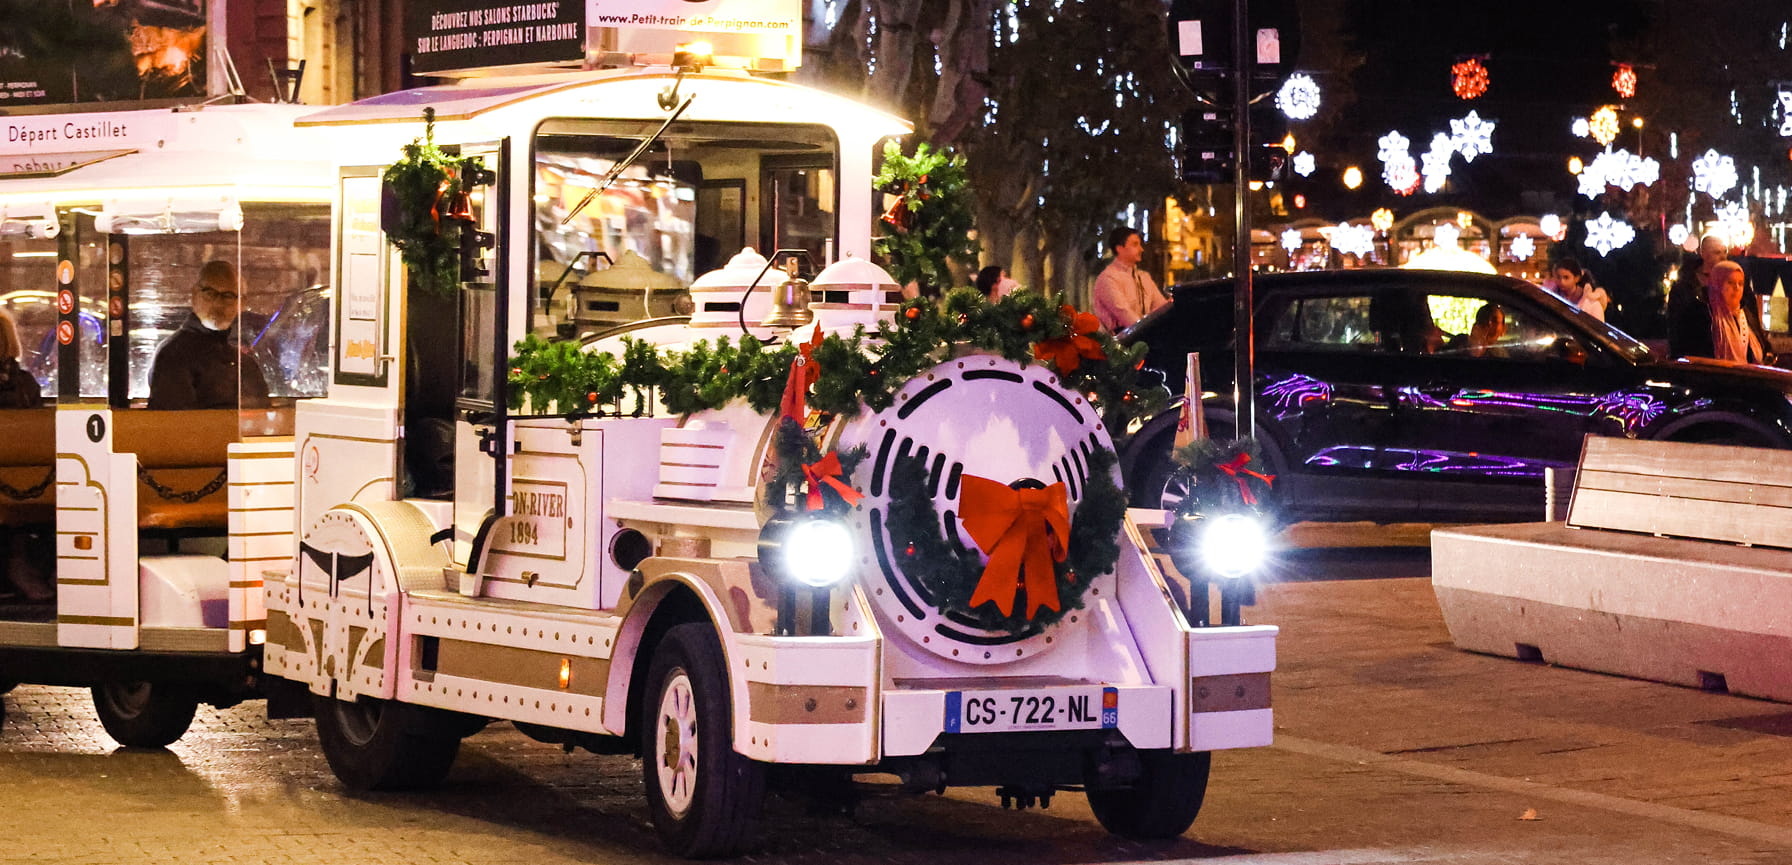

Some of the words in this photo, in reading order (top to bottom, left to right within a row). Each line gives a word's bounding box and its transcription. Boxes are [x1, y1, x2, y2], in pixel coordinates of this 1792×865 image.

[431, 11, 467, 30] DÉCOUVREZ
[469, 10, 483, 27] NOS
[484, 6, 511, 25] SALONS
[417, 38, 430, 53] SUR
[432, 37, 438, 52] LE
[440, 32, 477, 51] LANGUEDOC
[483, 27, 523, 47] PERPIGNAN
[525, 26, 534, 43] ET
[536, 22, 578, 41] NARBONNE
[9, 125, 57, 148] Départ
[64, 121, 127, 139] Castillet
[510, 521, 538, 545] 1894
[966, 695, 1097, 725] CS-722-NL
[1103, 712, 1116, 724] 66
